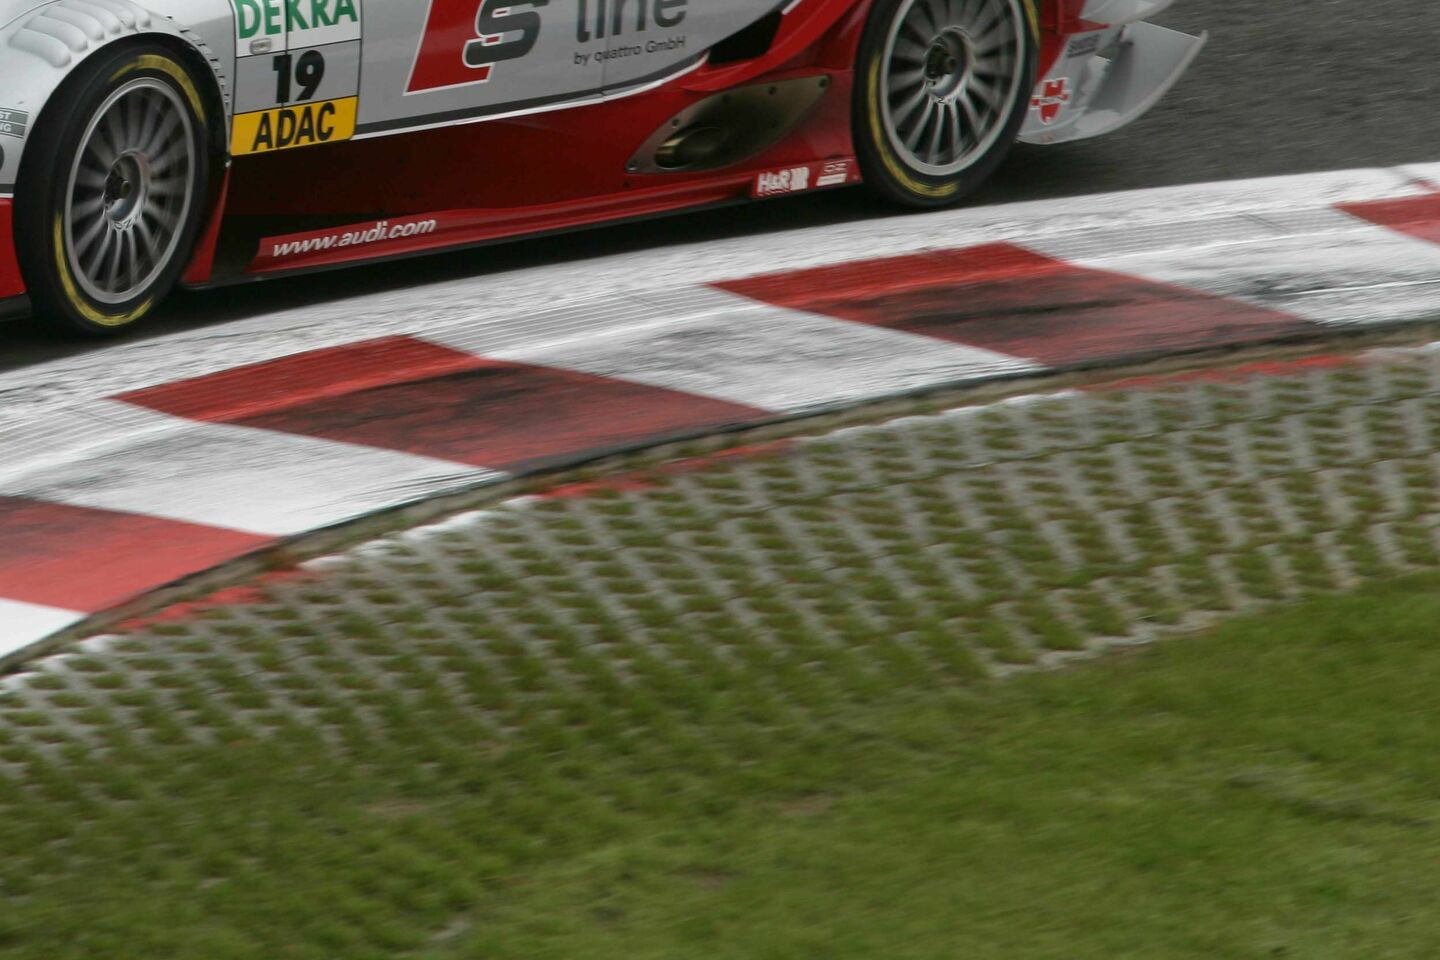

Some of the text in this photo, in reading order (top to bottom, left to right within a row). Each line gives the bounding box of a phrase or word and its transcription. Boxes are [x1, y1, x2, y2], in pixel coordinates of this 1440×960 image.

[573, 36, 686, 65] by quattro GmbH
[272, 49, 326, 104] 19
[251, 102, 336, 152] ADAC
[272, 218, 437, 257] www.audi.com
